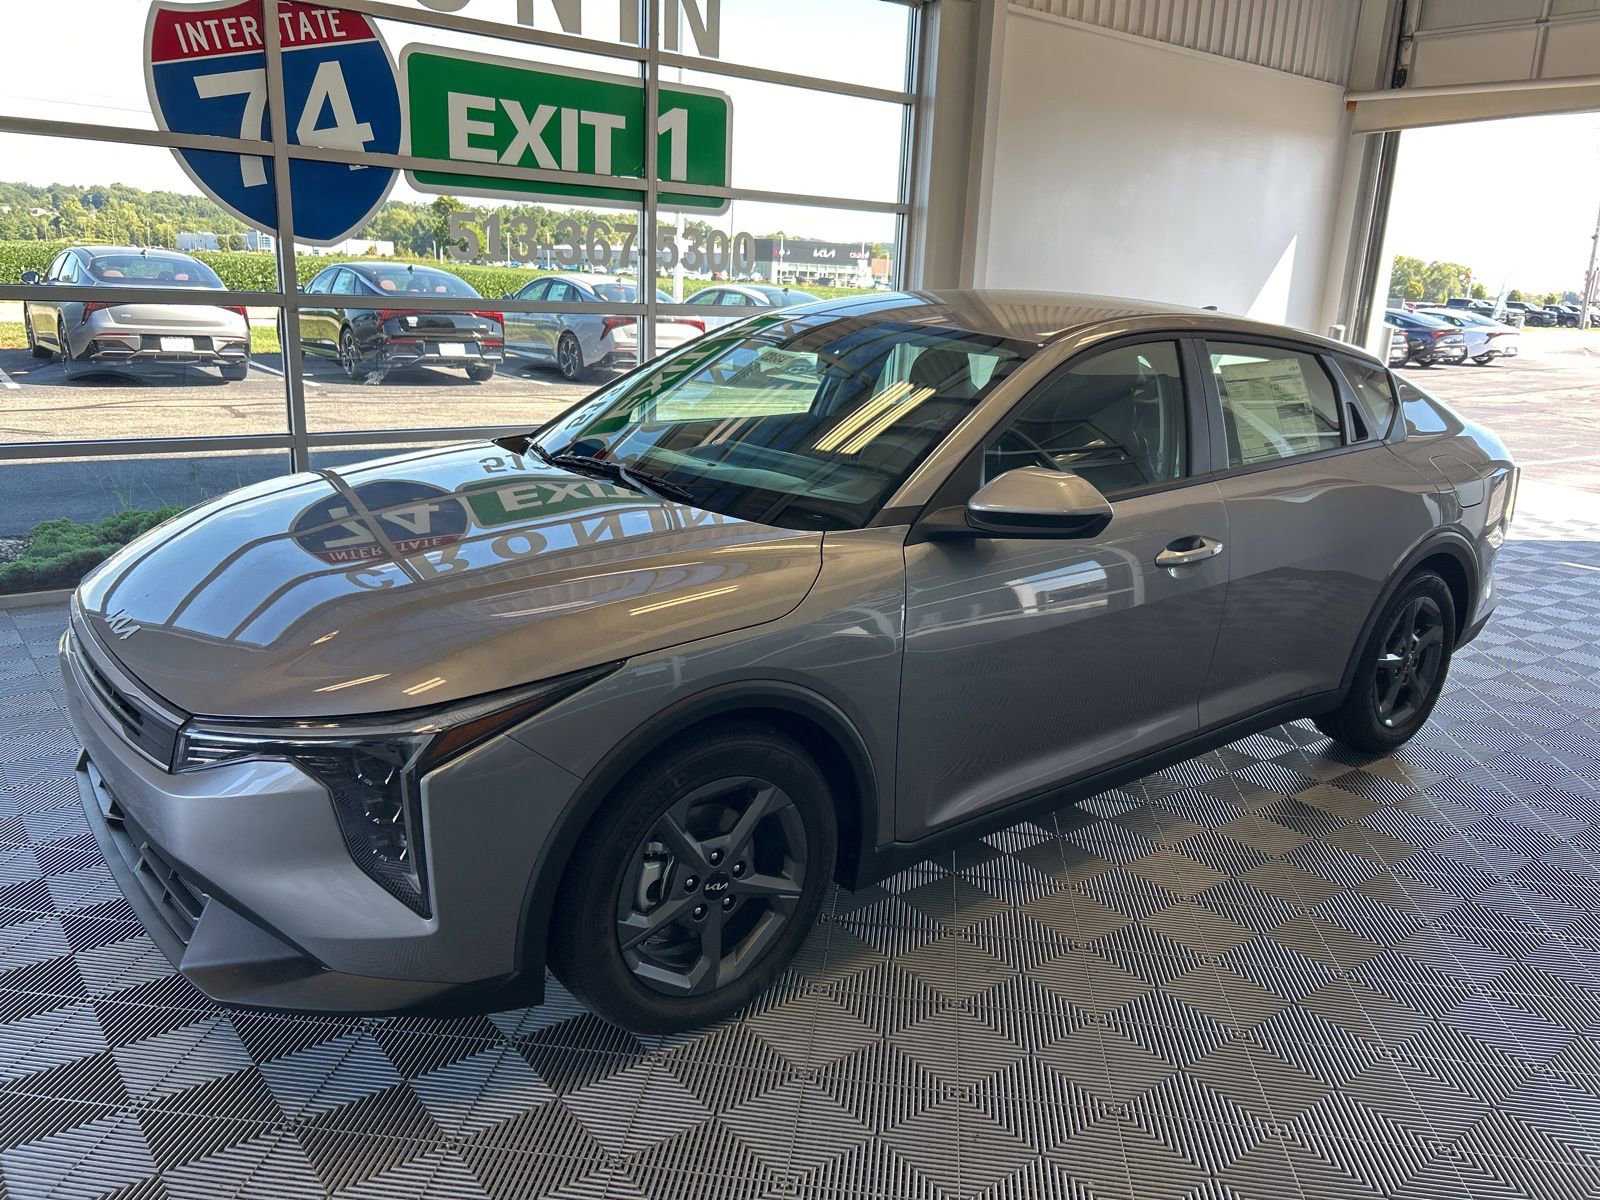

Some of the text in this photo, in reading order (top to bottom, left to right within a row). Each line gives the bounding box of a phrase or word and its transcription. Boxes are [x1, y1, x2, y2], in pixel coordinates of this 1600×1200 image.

[175, 9, 347, 54] INTERTATE
[193, 60, 375, 187] 74
[447, 91, 688, 182] EXIT 1
[104, 608, 141, 640] KIA
[704, 882, 729, 891] KIA
